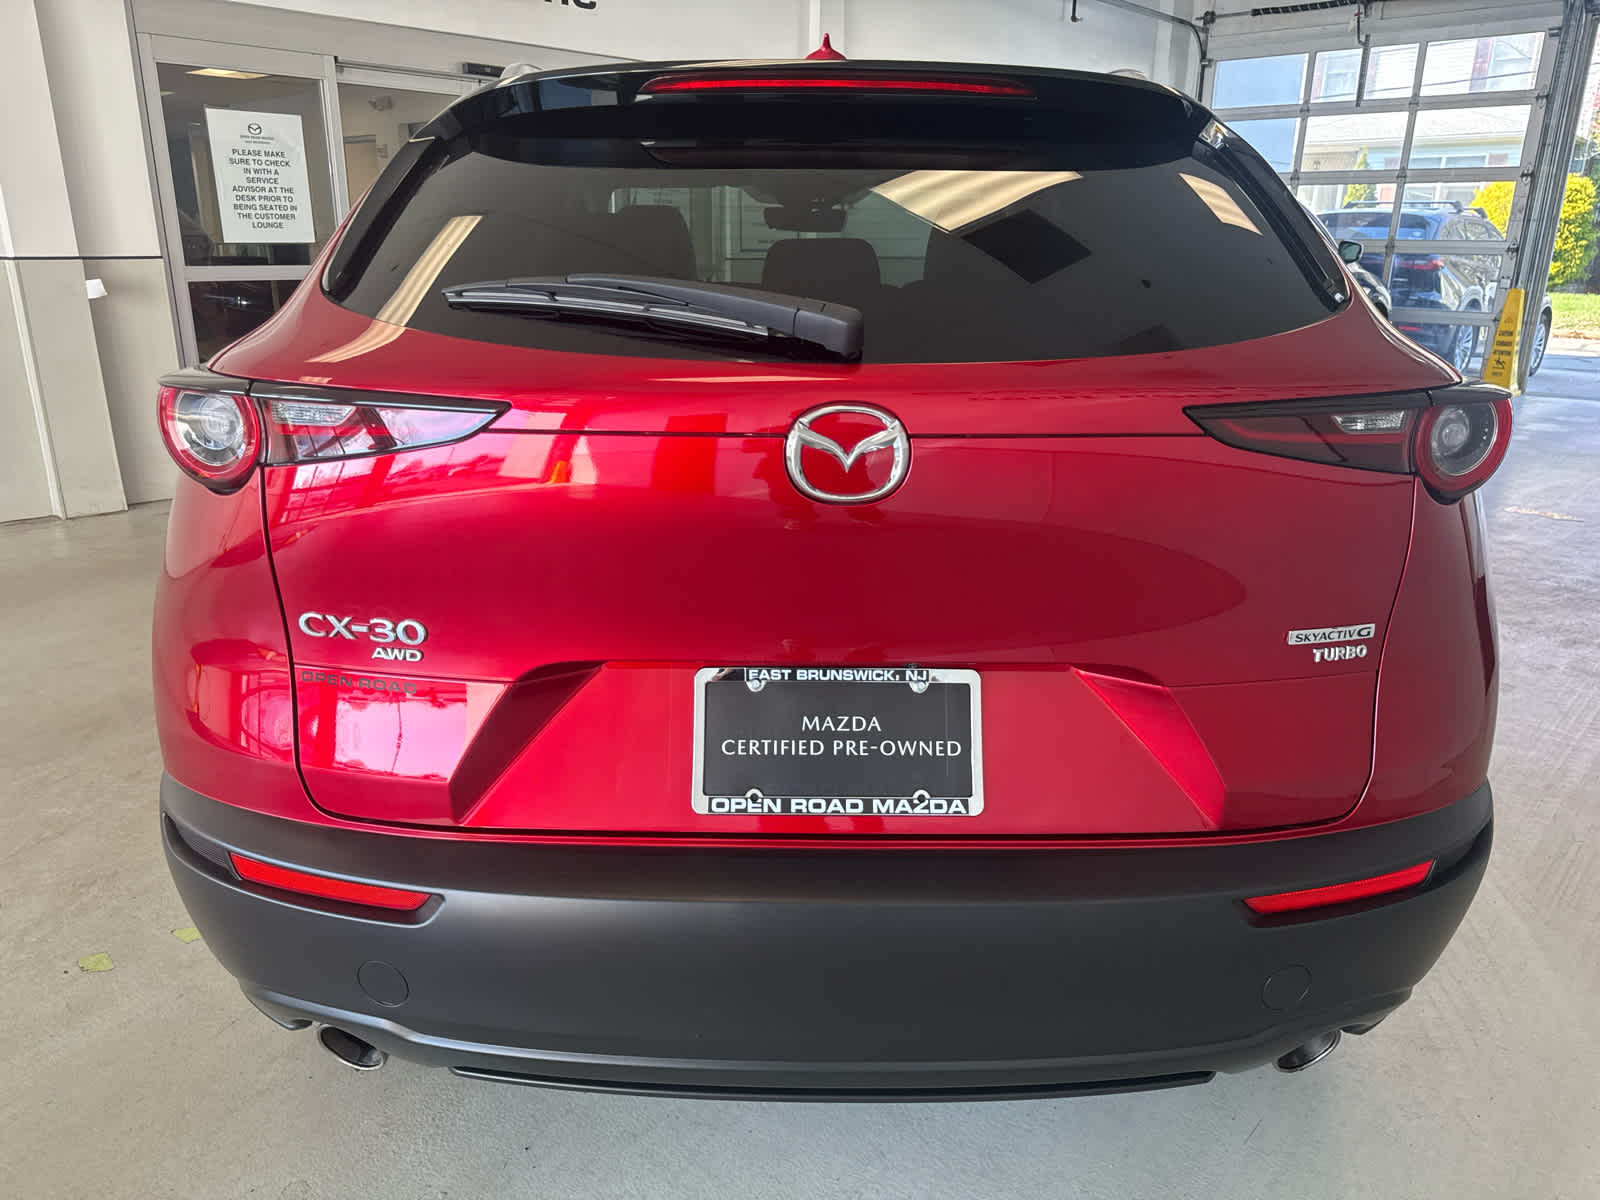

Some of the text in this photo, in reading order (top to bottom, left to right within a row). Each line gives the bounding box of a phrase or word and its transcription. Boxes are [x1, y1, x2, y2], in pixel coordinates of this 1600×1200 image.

[232, 149, 286, 158] PLEASE MAKE
[230, 158, 251, 166] SURE
[265, 160, 290, 168] CHECK
[253, 168, 272, 176] WITH
[247, 177, 279, 185] SERVICE
[269, 186, 279, 194] AT
[259, 195, 282, 203] PRIOR
[284, 195, 294, 203] TO
[259, 204, 289, 212] SEATED
[298, 611, 427, 646] CX-30
[371, 647, 424, 662] AWD
[1313, 645, 1367, 662] TURBO
[748, 669, 792, 681] EAST
[905, 670, 928, 681] NJ
[301, 671, 417, 694] OPEN ROAD
[801, 716, 882, 732] MAZDA
[721, 739, 962, 757] CERTIFIED PRE-OWNED
[711, 798, 782, 813] OPEN
[790, 798, 864, 813] ROAD
